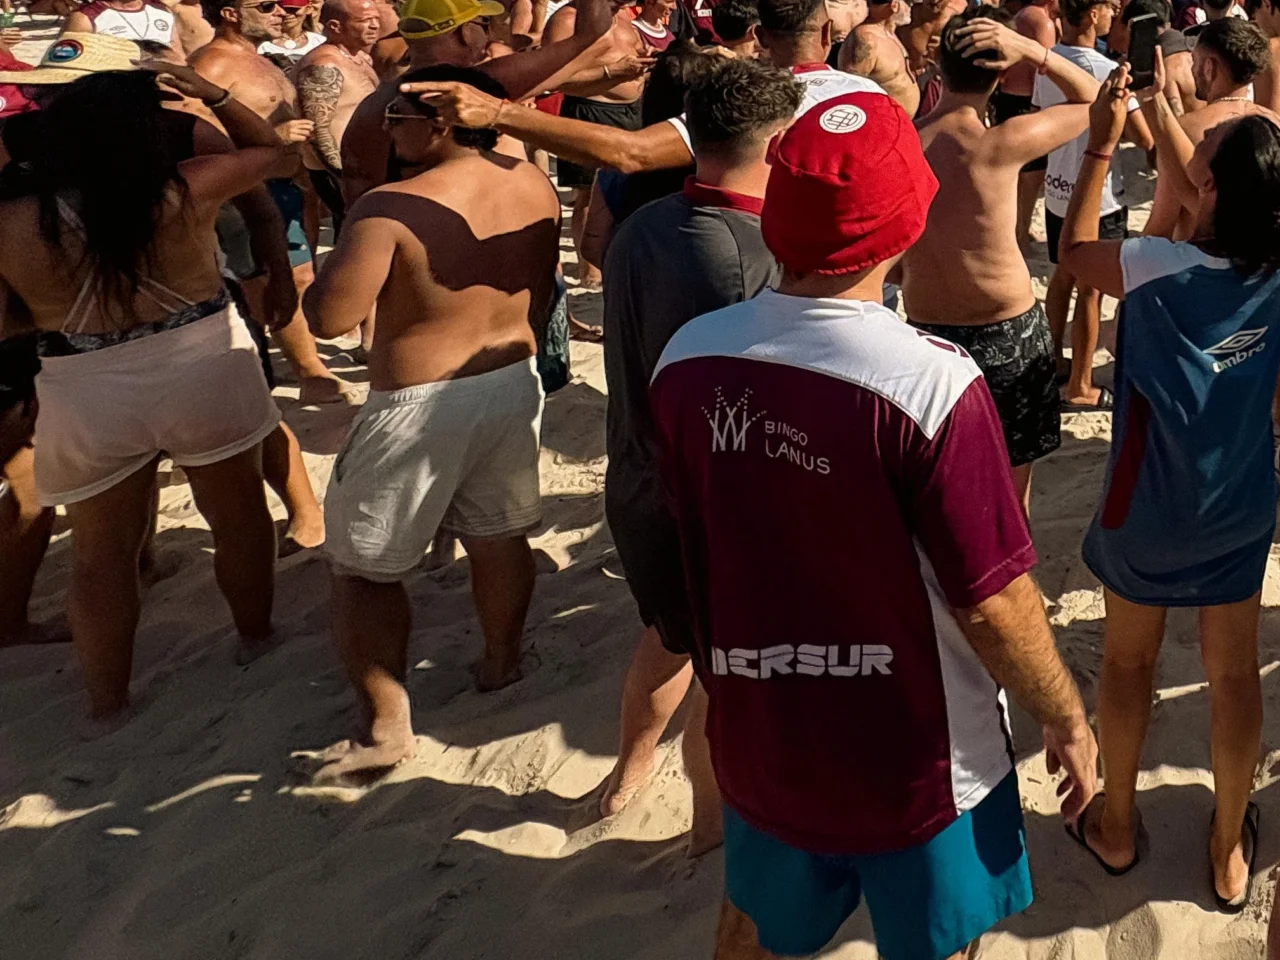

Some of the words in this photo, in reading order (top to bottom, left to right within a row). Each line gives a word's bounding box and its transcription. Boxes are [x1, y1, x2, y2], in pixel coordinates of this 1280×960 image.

[1212, 342, 1266, 373] umbro
[765, 420, 808, 446] BINGO
[765, 438, 831, 474] LANUS
